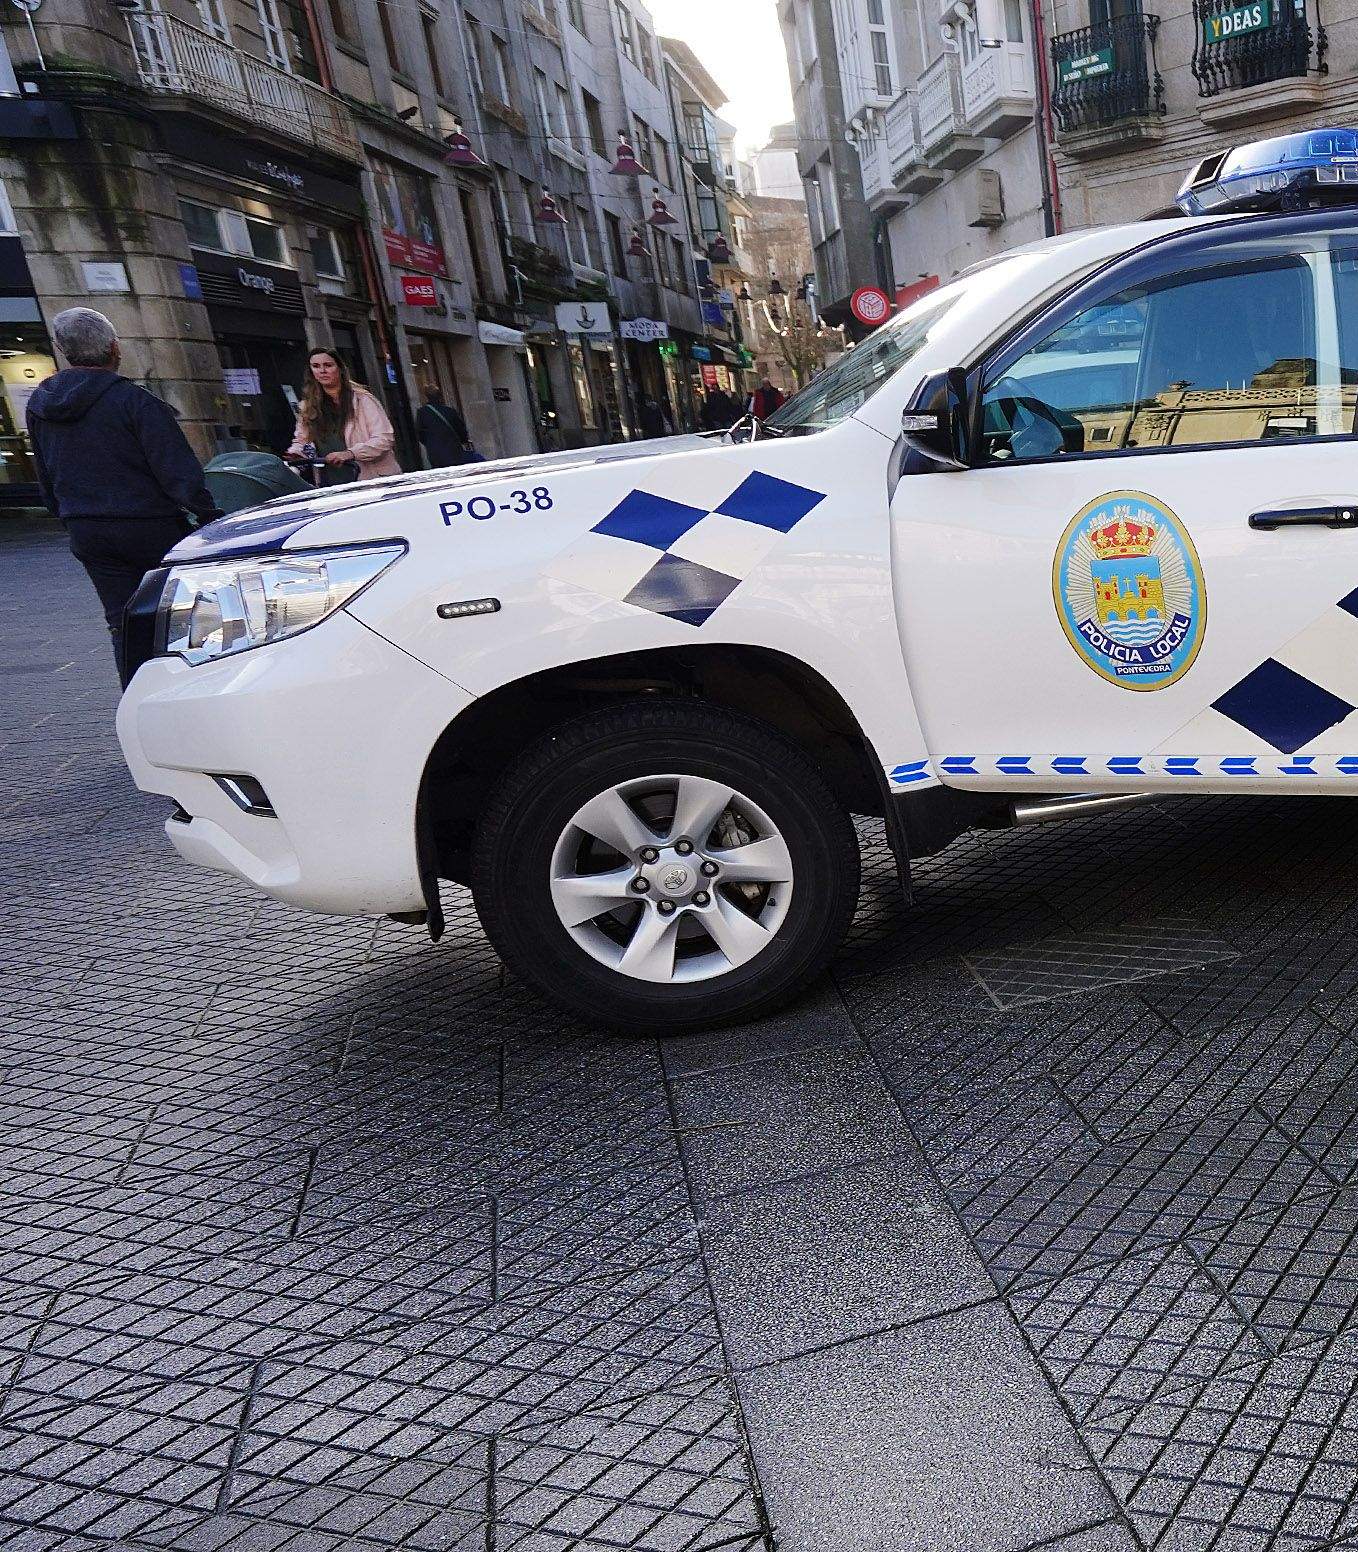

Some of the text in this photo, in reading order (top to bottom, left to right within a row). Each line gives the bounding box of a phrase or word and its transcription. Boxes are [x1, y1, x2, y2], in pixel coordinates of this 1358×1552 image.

[1211, 5, 1262, 37] YDEAS
[405, 285, 434, 295] GAES
[628, 322, 659, 330] MODA
[439, 486, 554, 526] PO-38
[1080, 619, 1189, 662] POLICIA LOCAL
[1117, 664, 1171, 674] PONTEVEDRA
